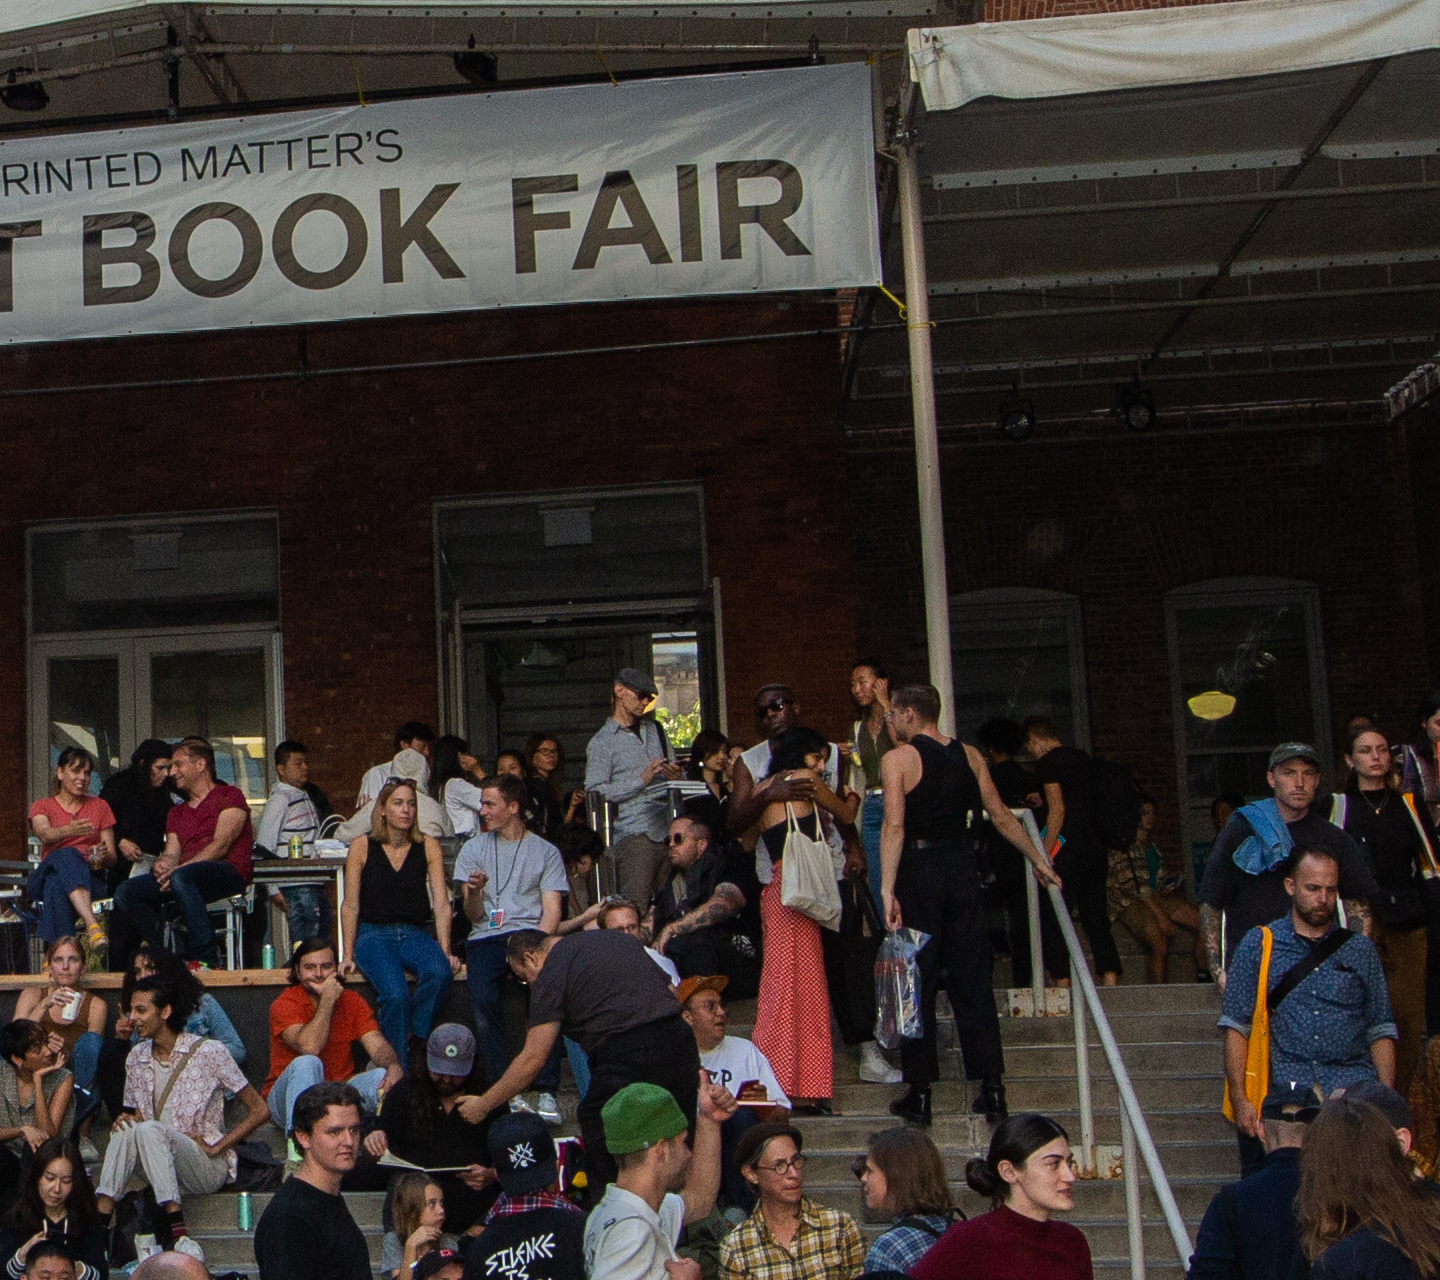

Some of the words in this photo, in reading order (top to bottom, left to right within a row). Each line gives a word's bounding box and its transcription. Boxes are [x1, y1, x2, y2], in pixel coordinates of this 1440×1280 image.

[182, 127, 404, 183] MATTER'S
[82, 182, 467, 307] BOOK
[511, 158, 812, 275] FAIR
[485, 1232, 556, 1276] SILENCE
